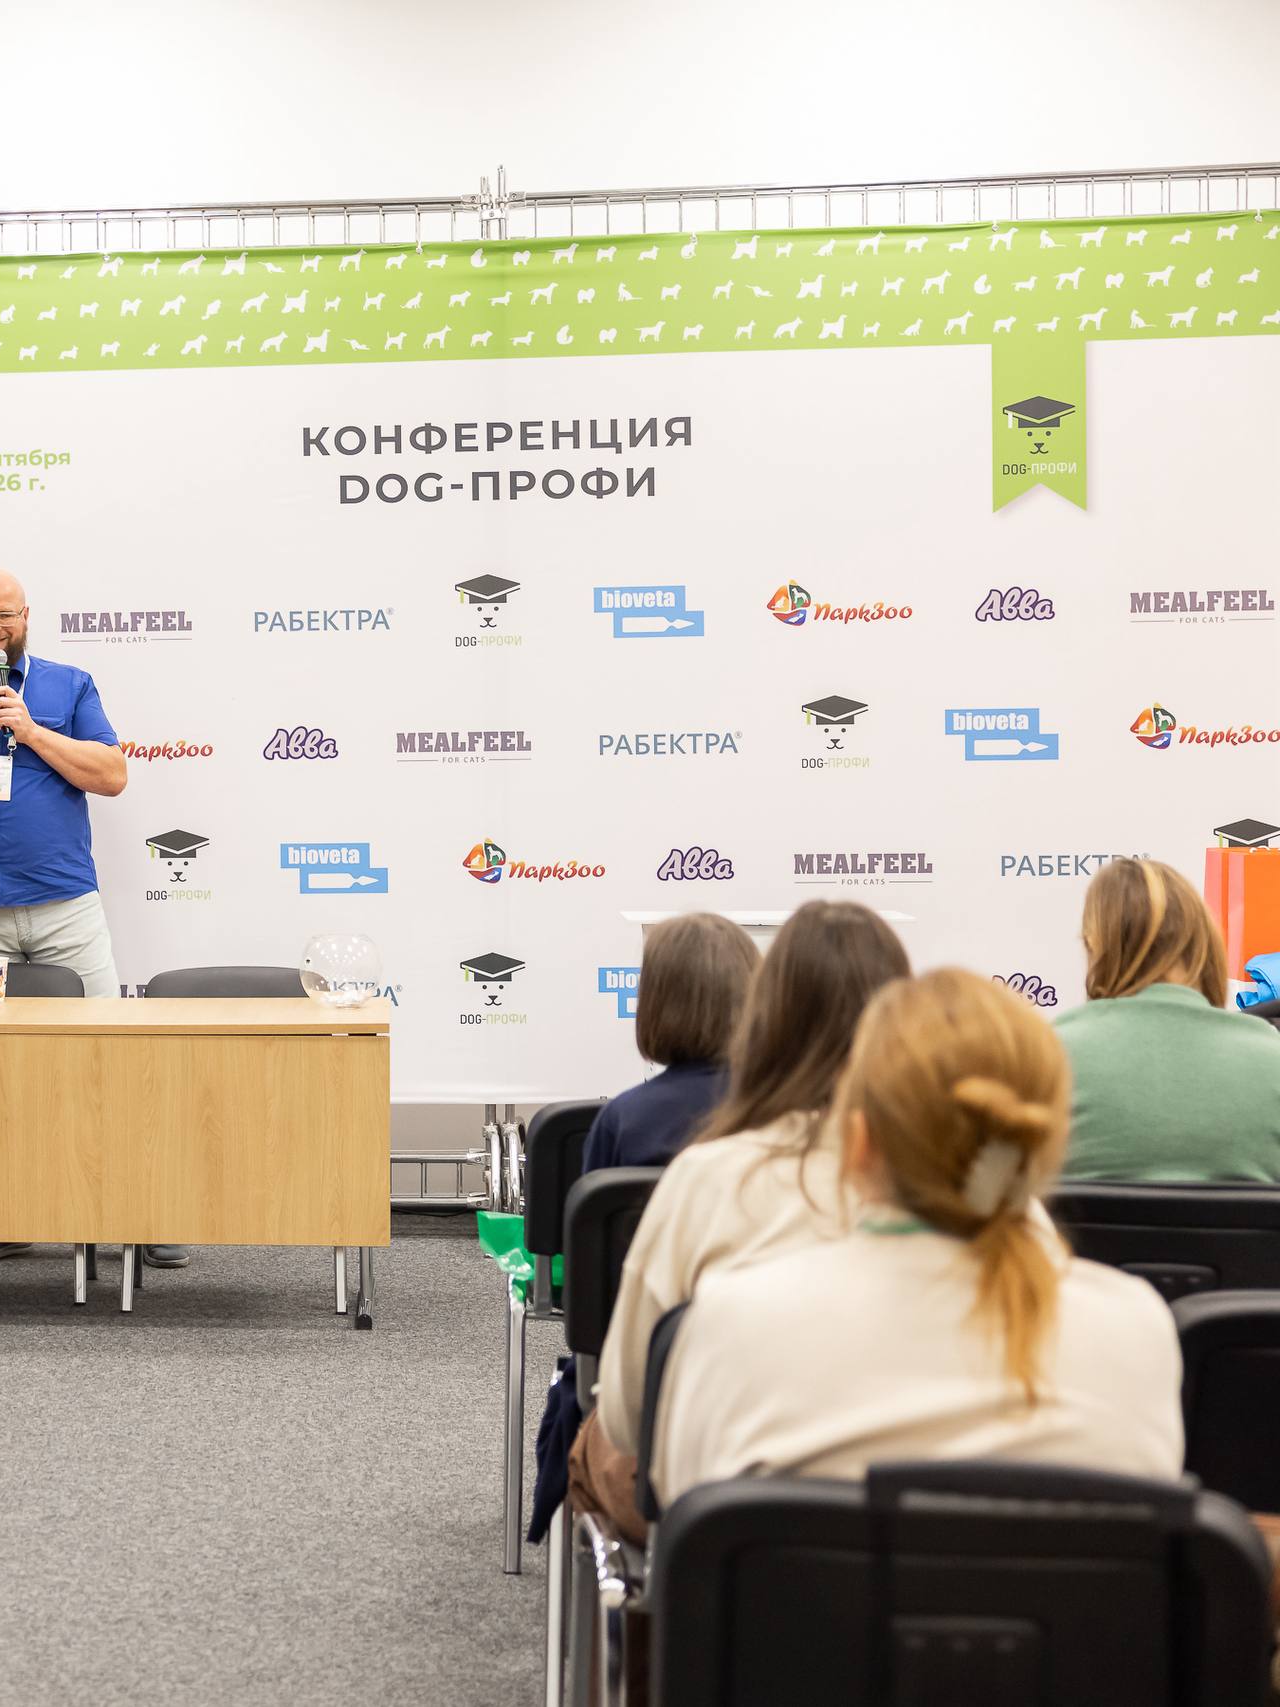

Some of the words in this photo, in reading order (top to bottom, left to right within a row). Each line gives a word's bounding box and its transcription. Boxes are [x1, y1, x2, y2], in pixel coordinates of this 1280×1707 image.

[302, 416, 692, 457] КОНФЕРЕНЦИЯ
[1002, 462, 1077, 475] DOG-ПРОФИ
[29, 478, 45, 491] г.
[340, 467, 655, 504] DOG-ПРОФИ
[602, 590, 676, 609] bioveta
[1130, 589, 1275, 613] MEALFEEL
[60, 611, 192, 633] MEALFEEL
[455, 635, 523, 647] DOG-ПРОФИ
[953, 712, 1029, 731] bioveta
[396, 731, 532, 753] MEALFEEL
[801, 757, 870, 769] DOG-ПРОФИ
[288, 846, 361, 865] bioveta
[793, 853, 933, 874] MEALFEEL
[146, 889, 212, 901] DOG-ПРОФИ
[460, 1013, 527, 1025] DOG-ПРОФИ
